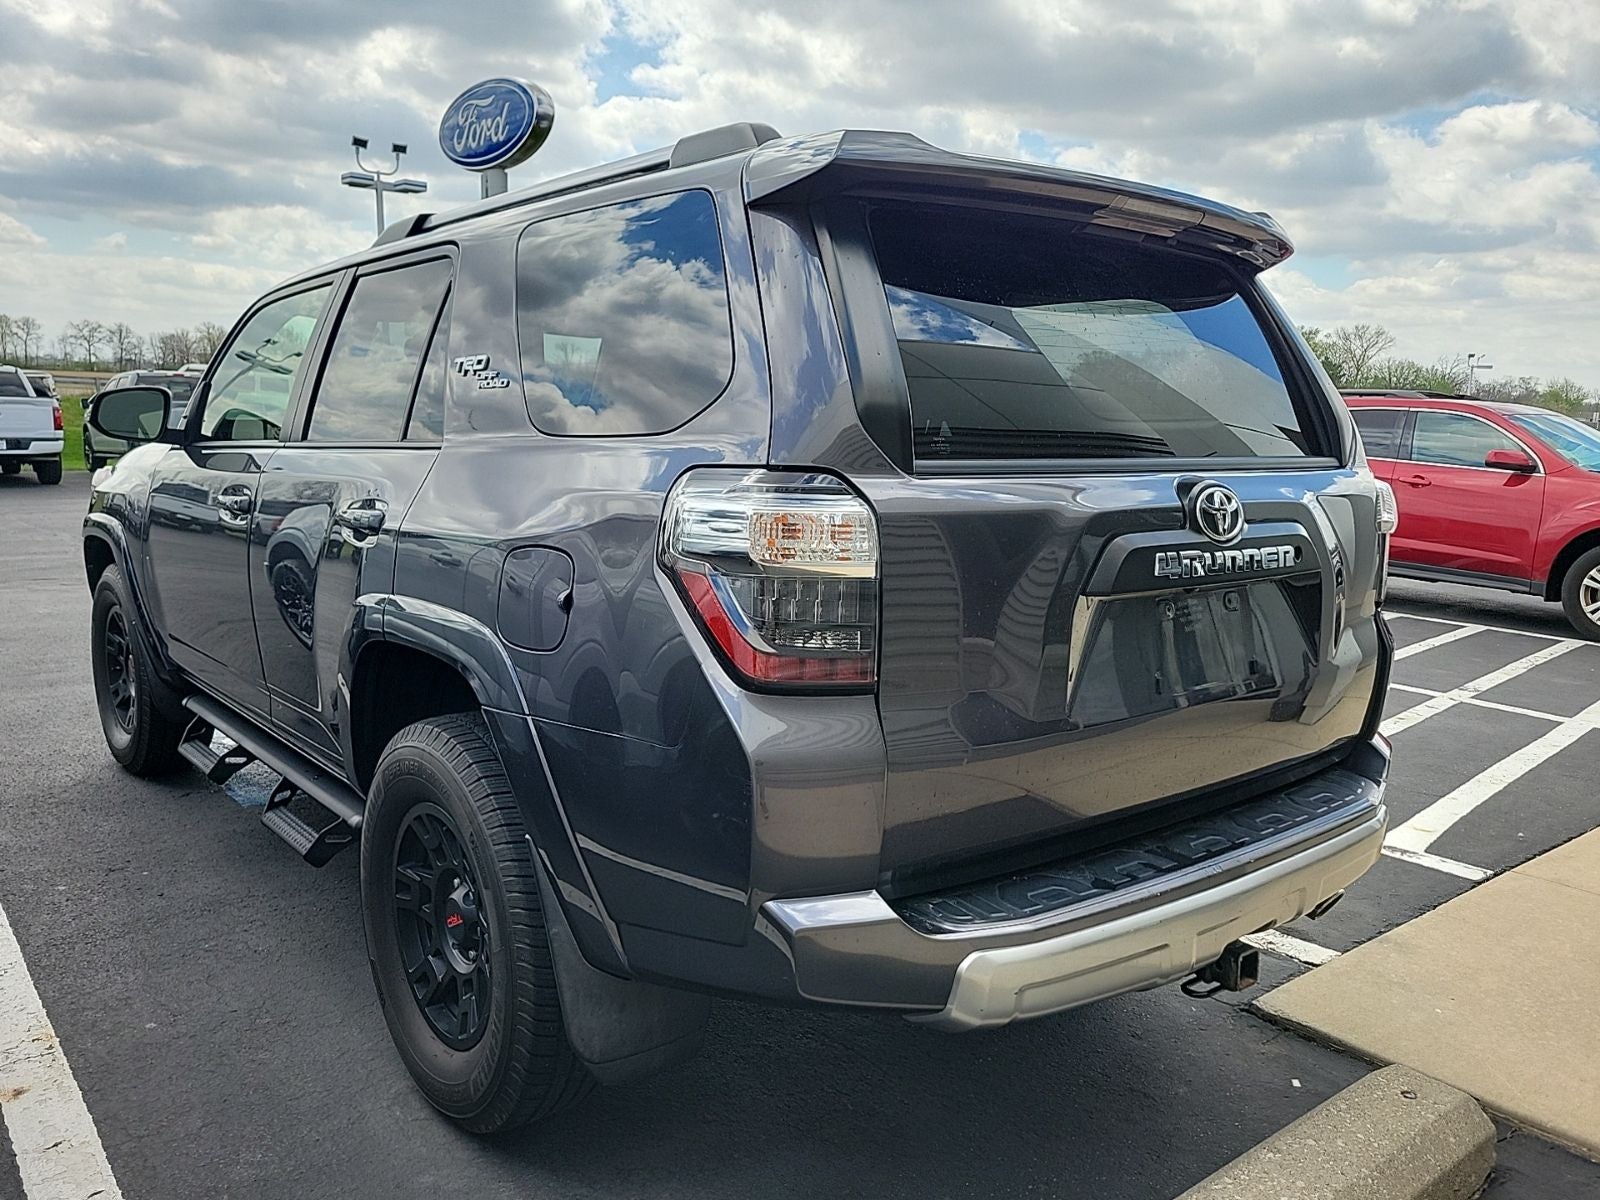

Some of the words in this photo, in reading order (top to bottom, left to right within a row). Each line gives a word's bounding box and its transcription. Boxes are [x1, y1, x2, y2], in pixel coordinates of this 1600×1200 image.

[454, 95, 510, 152] Ford
[454, 354, 490, 376] TRD
[476, 370, 500, 381] OFF
[477, 378, 511, 390] ROAD
[1154, 545, 1296, 579] 4RUNNER
